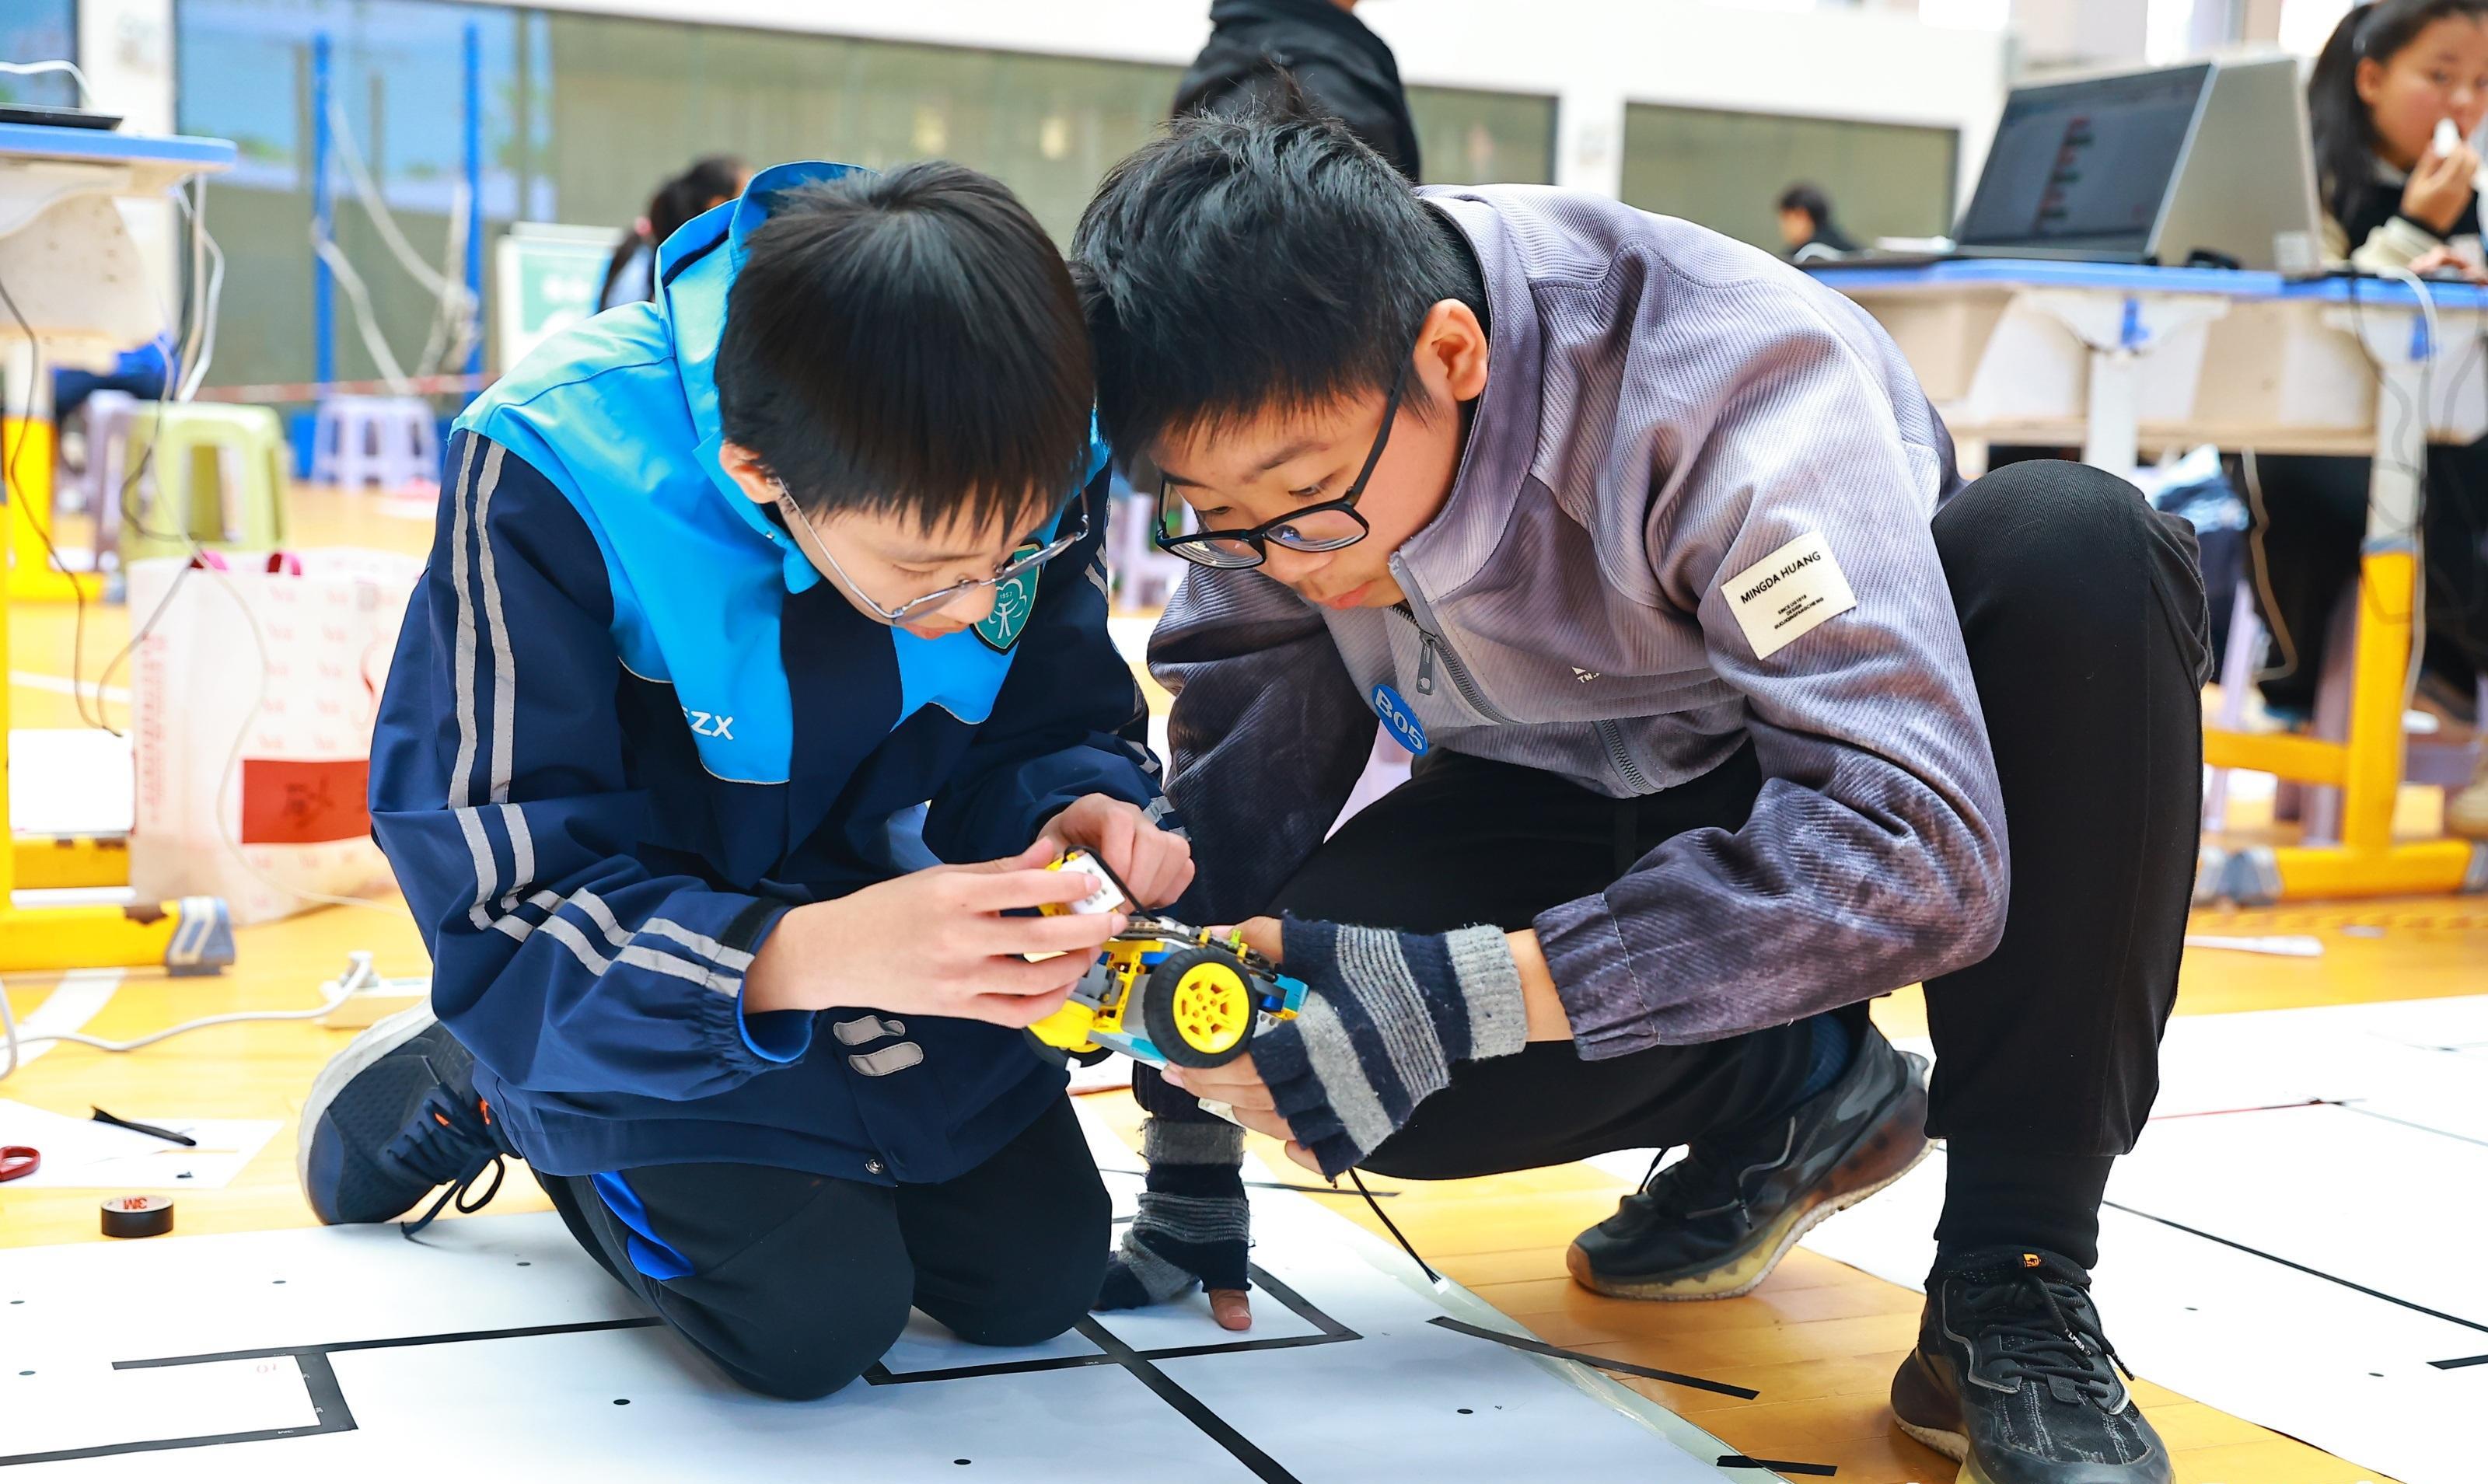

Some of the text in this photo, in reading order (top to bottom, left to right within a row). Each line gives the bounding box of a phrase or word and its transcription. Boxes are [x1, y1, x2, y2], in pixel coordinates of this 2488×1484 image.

[1740, 551, 1821, 604] MINGDA HUANG
[1777, 603, 1790, 615] SINCE
[1786, 604, 1802, 616] DESIGN
[124, 1198, 148, 1210] 3M
